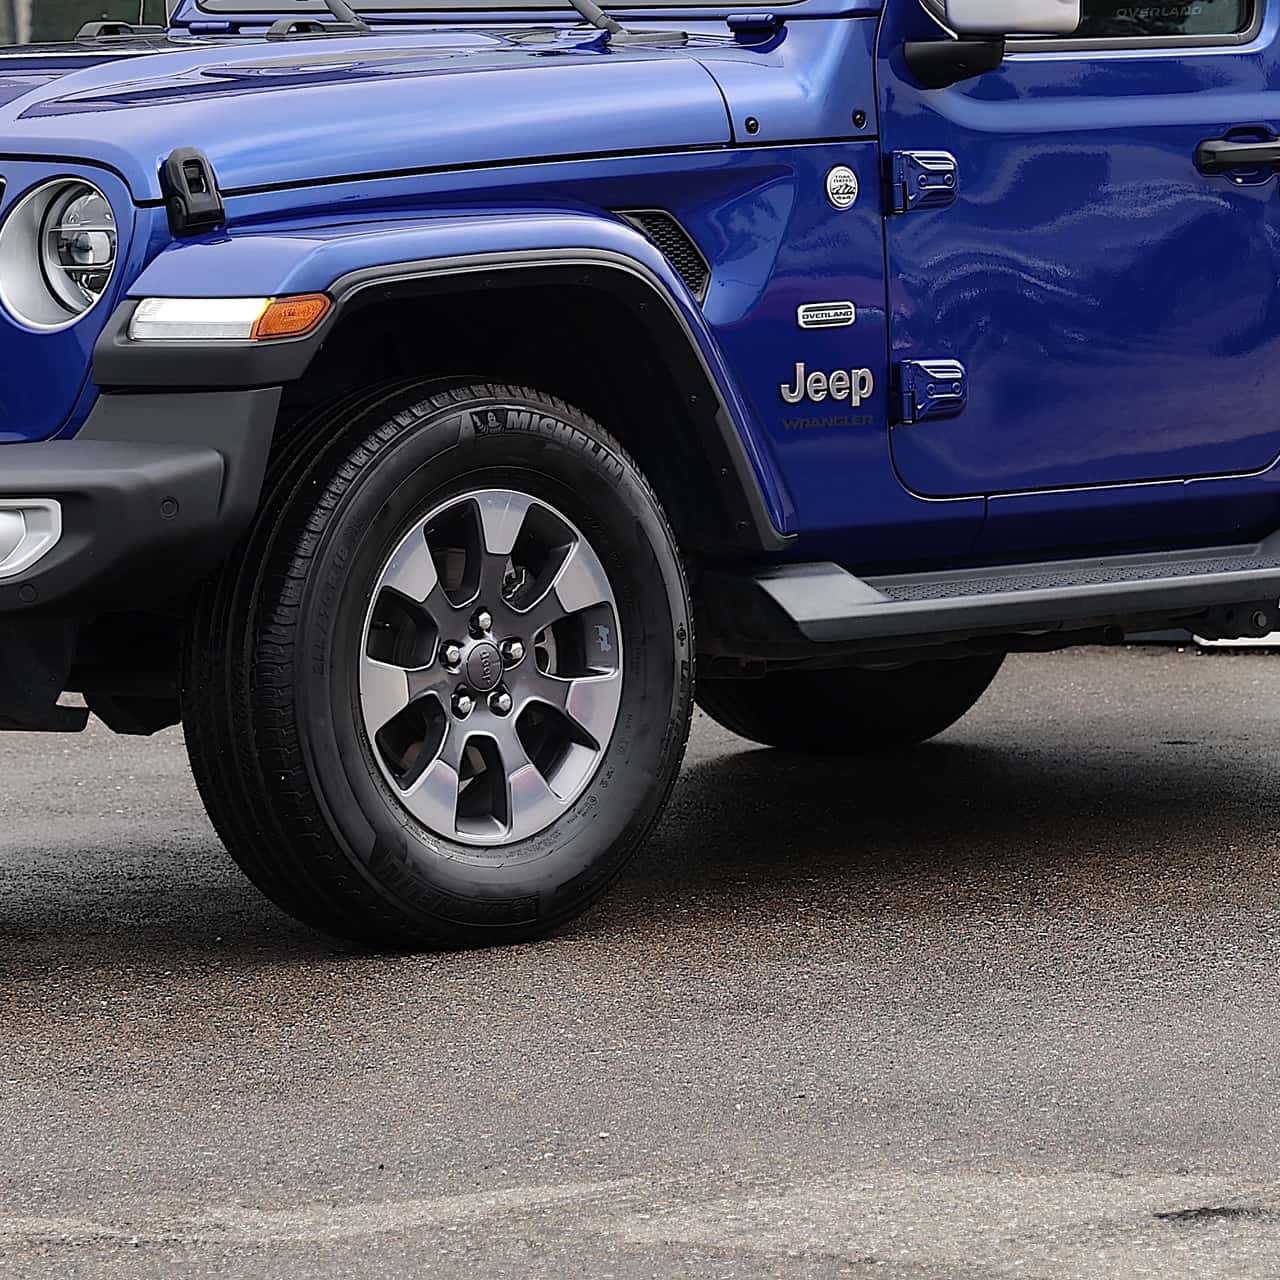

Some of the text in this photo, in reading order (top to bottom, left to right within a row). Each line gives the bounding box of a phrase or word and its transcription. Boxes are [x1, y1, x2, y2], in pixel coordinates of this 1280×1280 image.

[1115, 6, 1203, 18] OVERLAND
[801, 309, 853, 320] OVERLAND
[780, 362, 874, 407] Jeep
[783, 414, 873, 431] WRANGLER
[506, 411, 625, 483] MICHELIN
